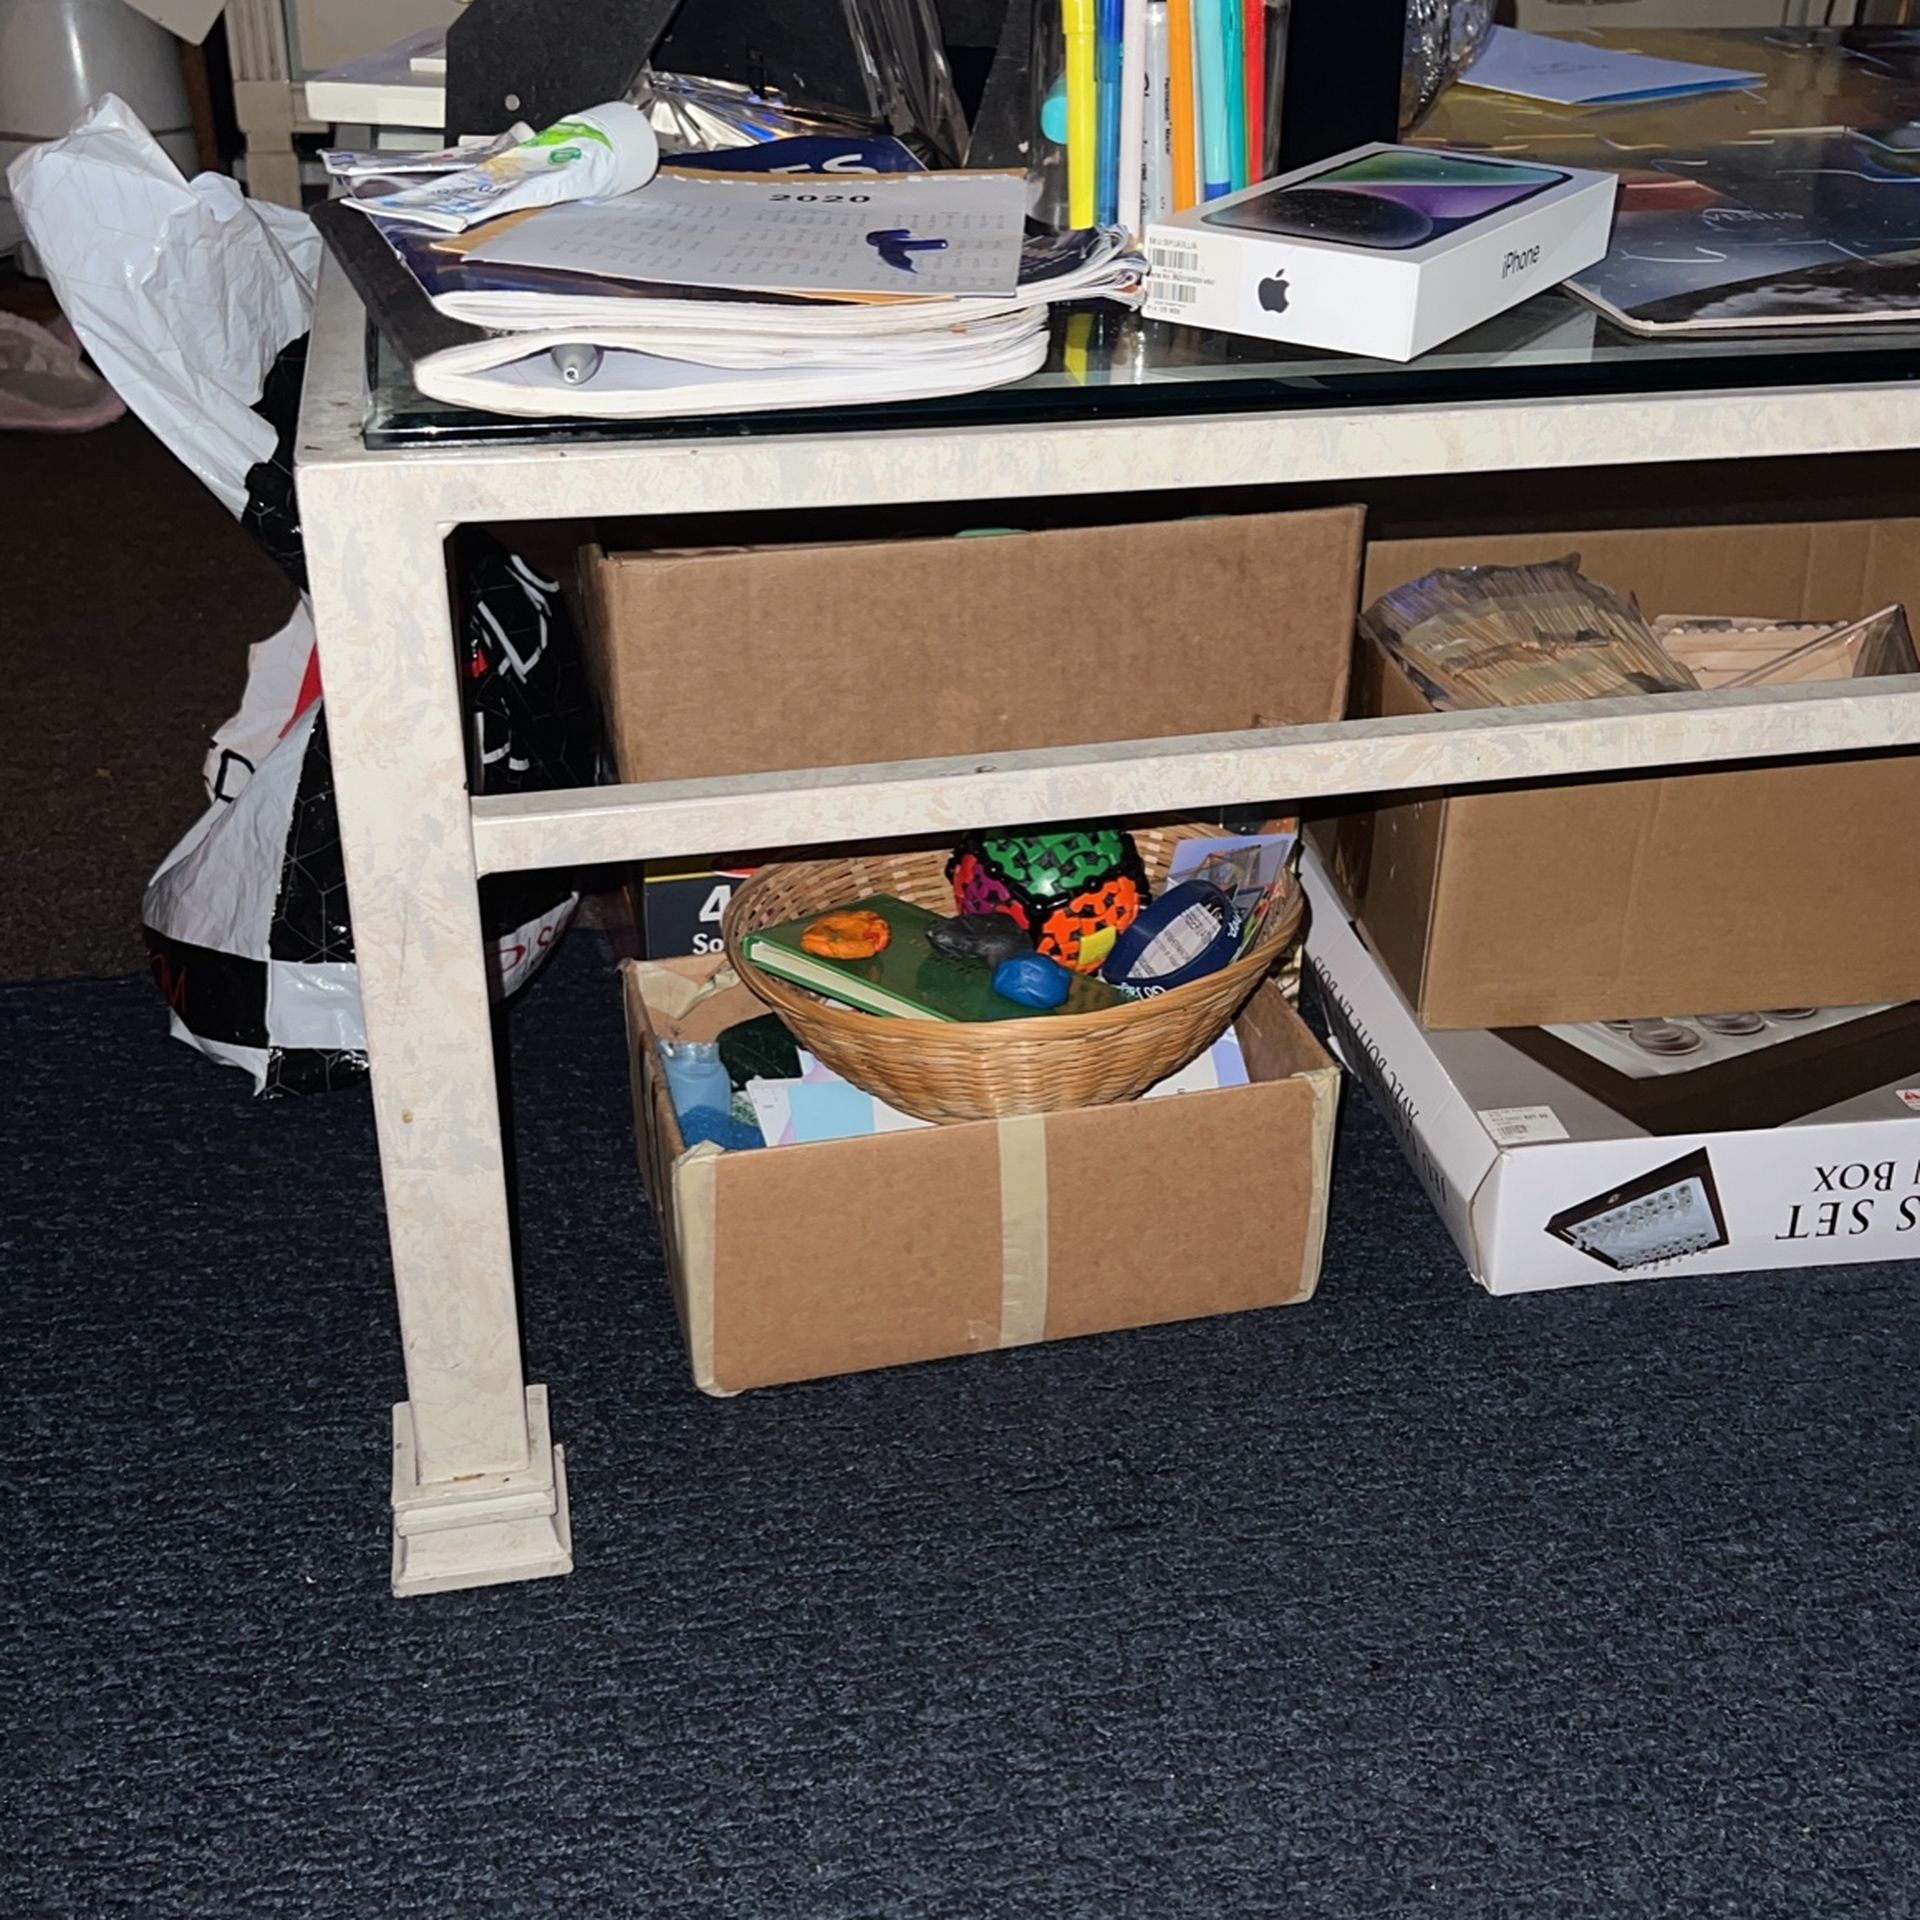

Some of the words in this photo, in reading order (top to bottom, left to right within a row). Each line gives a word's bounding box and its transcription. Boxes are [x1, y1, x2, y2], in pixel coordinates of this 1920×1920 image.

[769, 193, 871, 203] 2020
[1501, 244, 1540, 279] iPhone
[1813, 1161, 1896, 1192] BOX
[1774, 1198, 1875, 1240] SET
